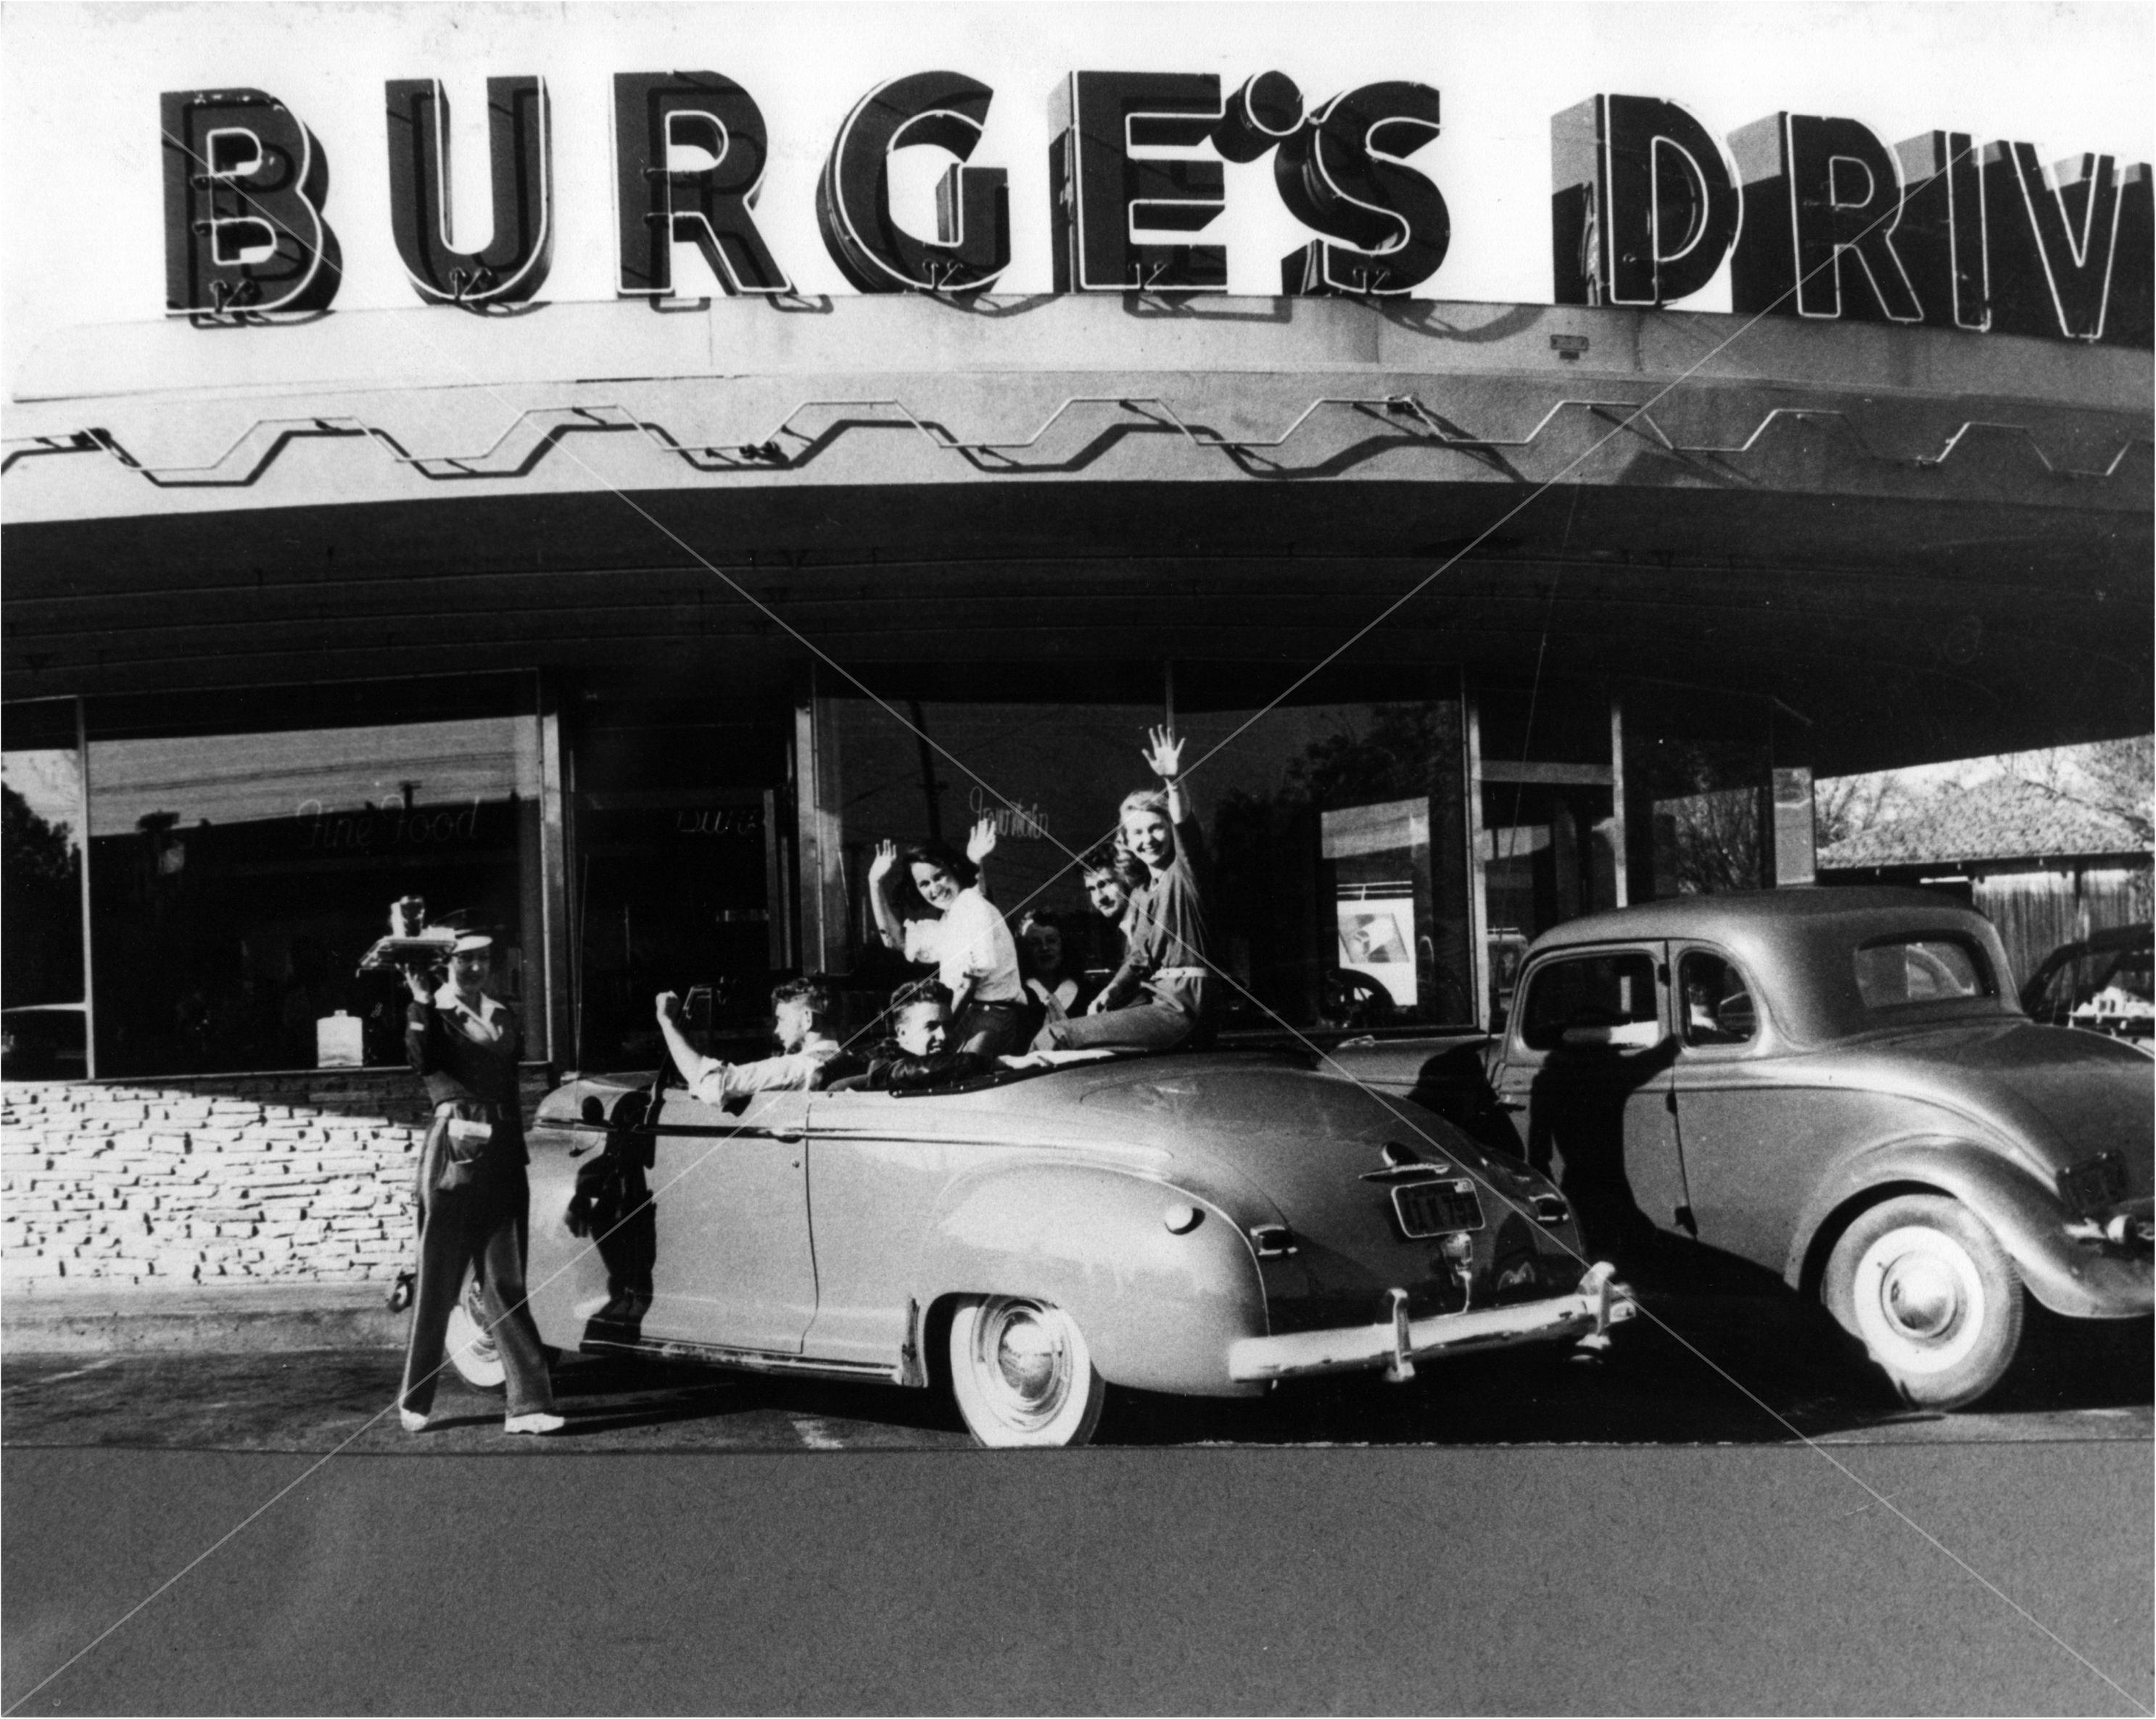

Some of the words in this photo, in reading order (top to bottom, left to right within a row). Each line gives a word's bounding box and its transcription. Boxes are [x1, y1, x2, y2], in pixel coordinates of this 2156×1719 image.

[160, 70, 1451, 317] BURGE'S
[1550, 94, 2155, 344] DRIV
[295, 798, 371, 849] Fine
[381, 793, 480, 845] Food
